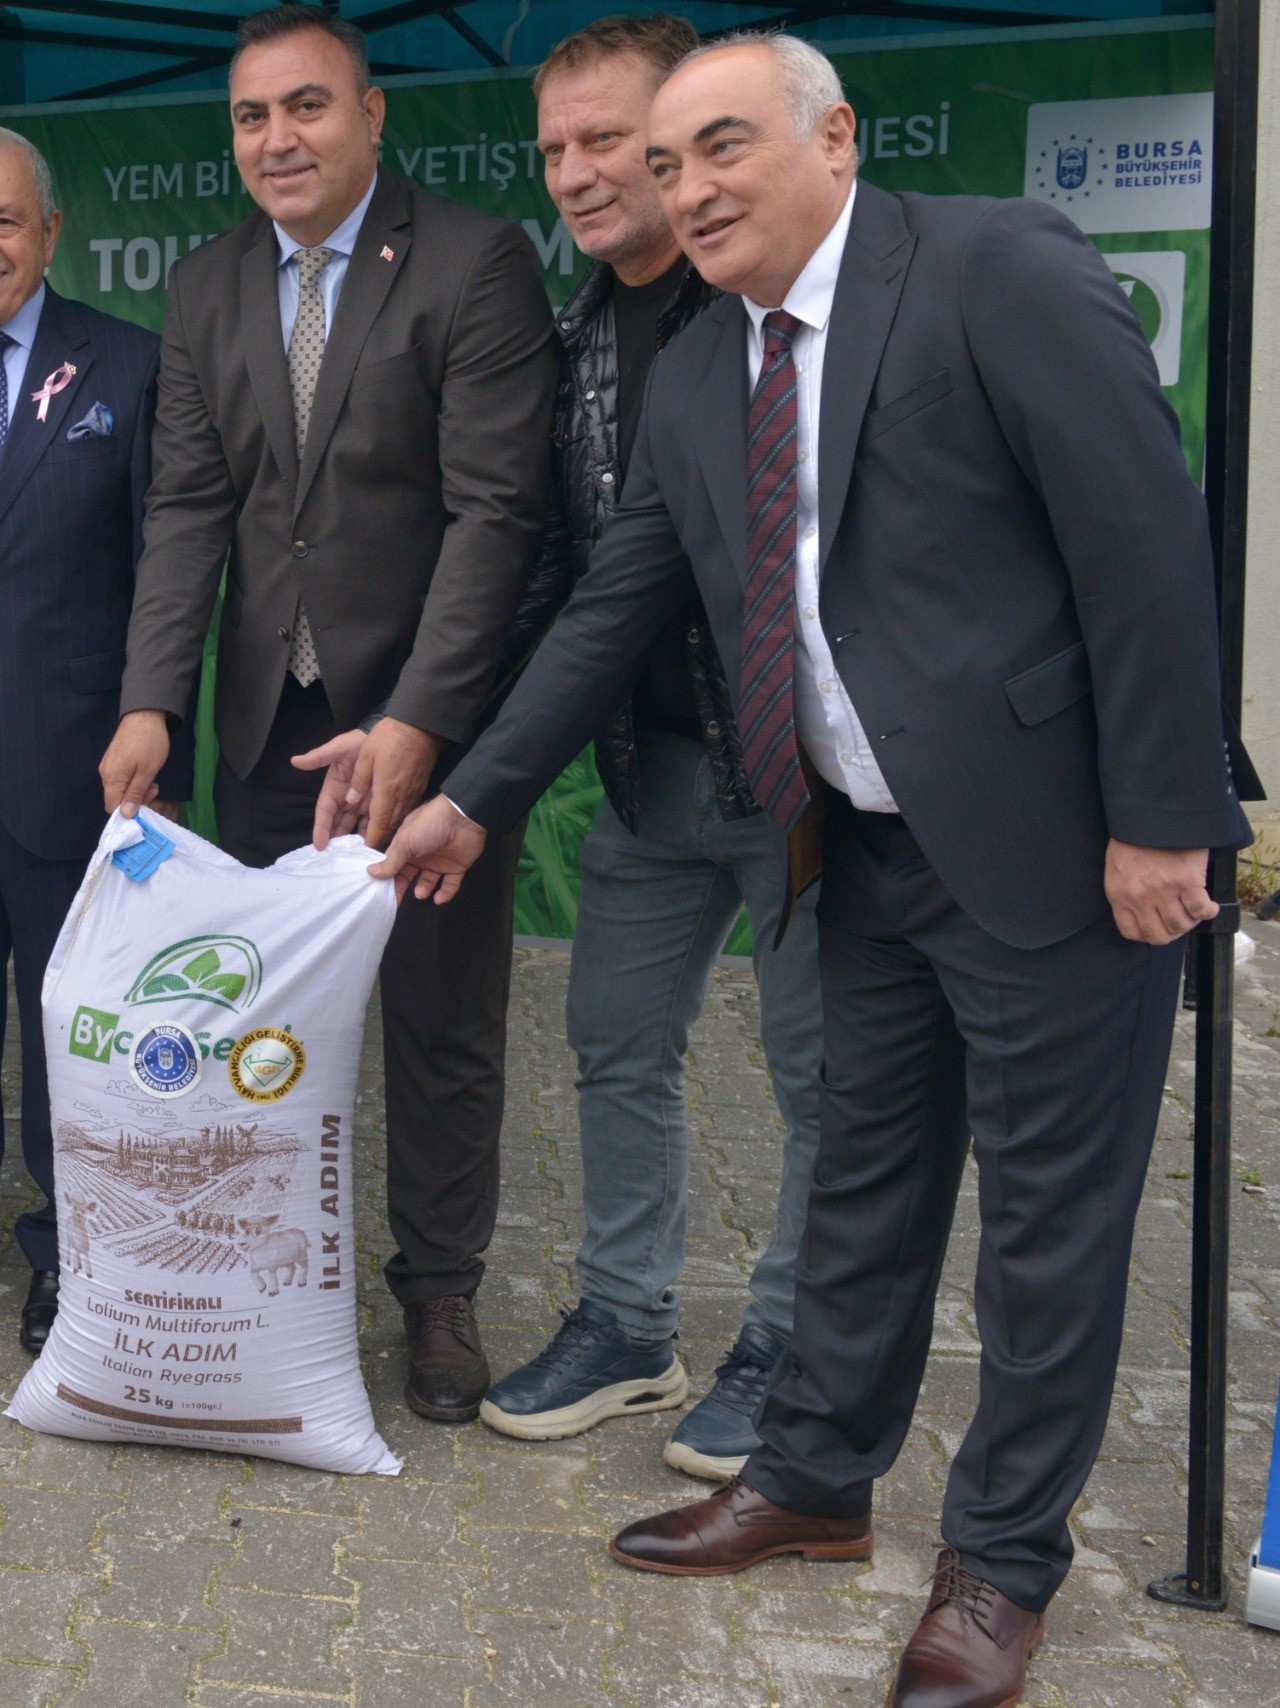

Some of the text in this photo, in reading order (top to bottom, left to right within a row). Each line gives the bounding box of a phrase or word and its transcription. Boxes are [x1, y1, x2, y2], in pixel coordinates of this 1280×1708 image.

[1116, 139, 1202, 159] BURSA
[1115, 157, 1201, 174] BÜYÜKŞEHİR
[1115, 170, 1201, 188] BELEDİYESİ
[103, 163, 183, 201] YEM
[74, 1013, 134, 1058] Byc
[154, 1027, 181, 1040] BURSA
[168, 1058, 198, 1092] BELEDİYESİ
[319, 1114, 341, 1289] İLK ADIM
[87, 1296, 269, 1334] Lolium Multiforum L.
[124, 1289, 222, 1311] SERTİFİKALI
[113, 1328, 237, 1362] İLK ADIM
[102, 1355, 242, 1386] Italian Ryegrass
[123, 1385, 222, 1411] 25 kg (±100gr.)
